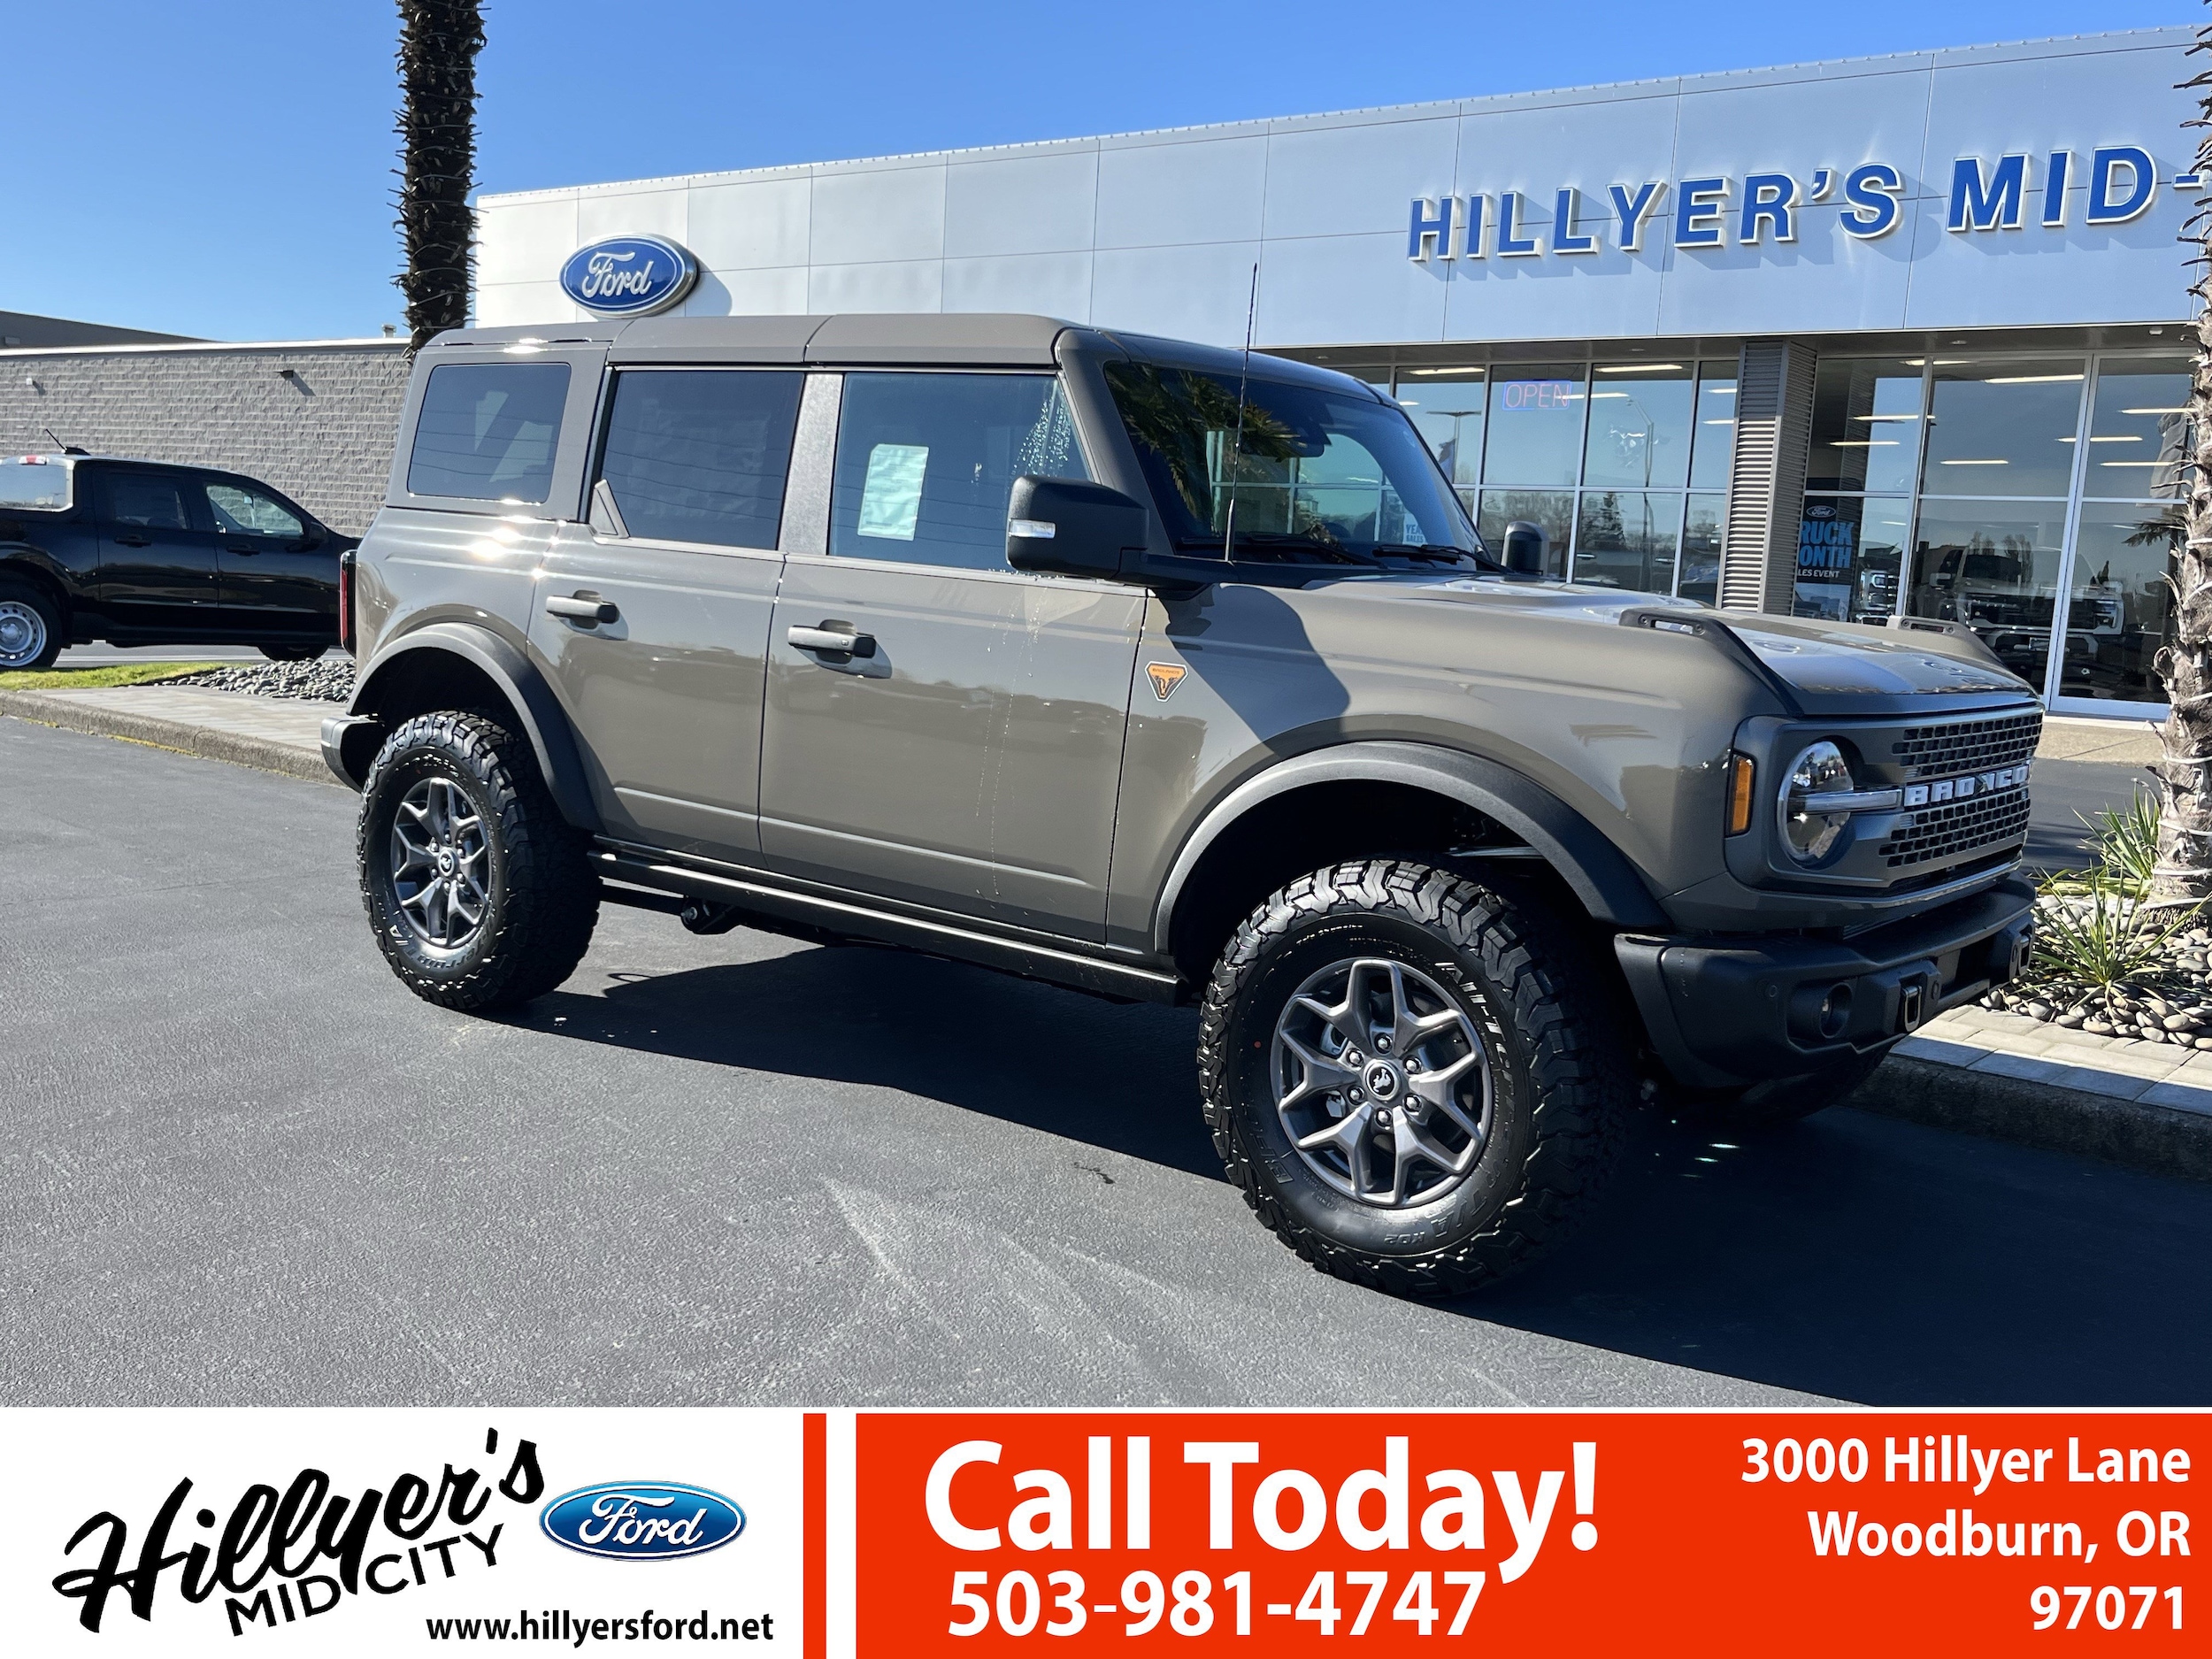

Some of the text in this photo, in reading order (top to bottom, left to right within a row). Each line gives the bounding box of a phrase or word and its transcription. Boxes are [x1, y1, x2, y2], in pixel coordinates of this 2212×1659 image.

[1409, 163, 1905, 261] HILLYER'S
[581, 252, 654, 298] Ford
[1506, 383, 1570, 408] OPEN
[1814, 570, 1839, 579] EVENT
[1904, 764, 2029, 806] BRONCO
